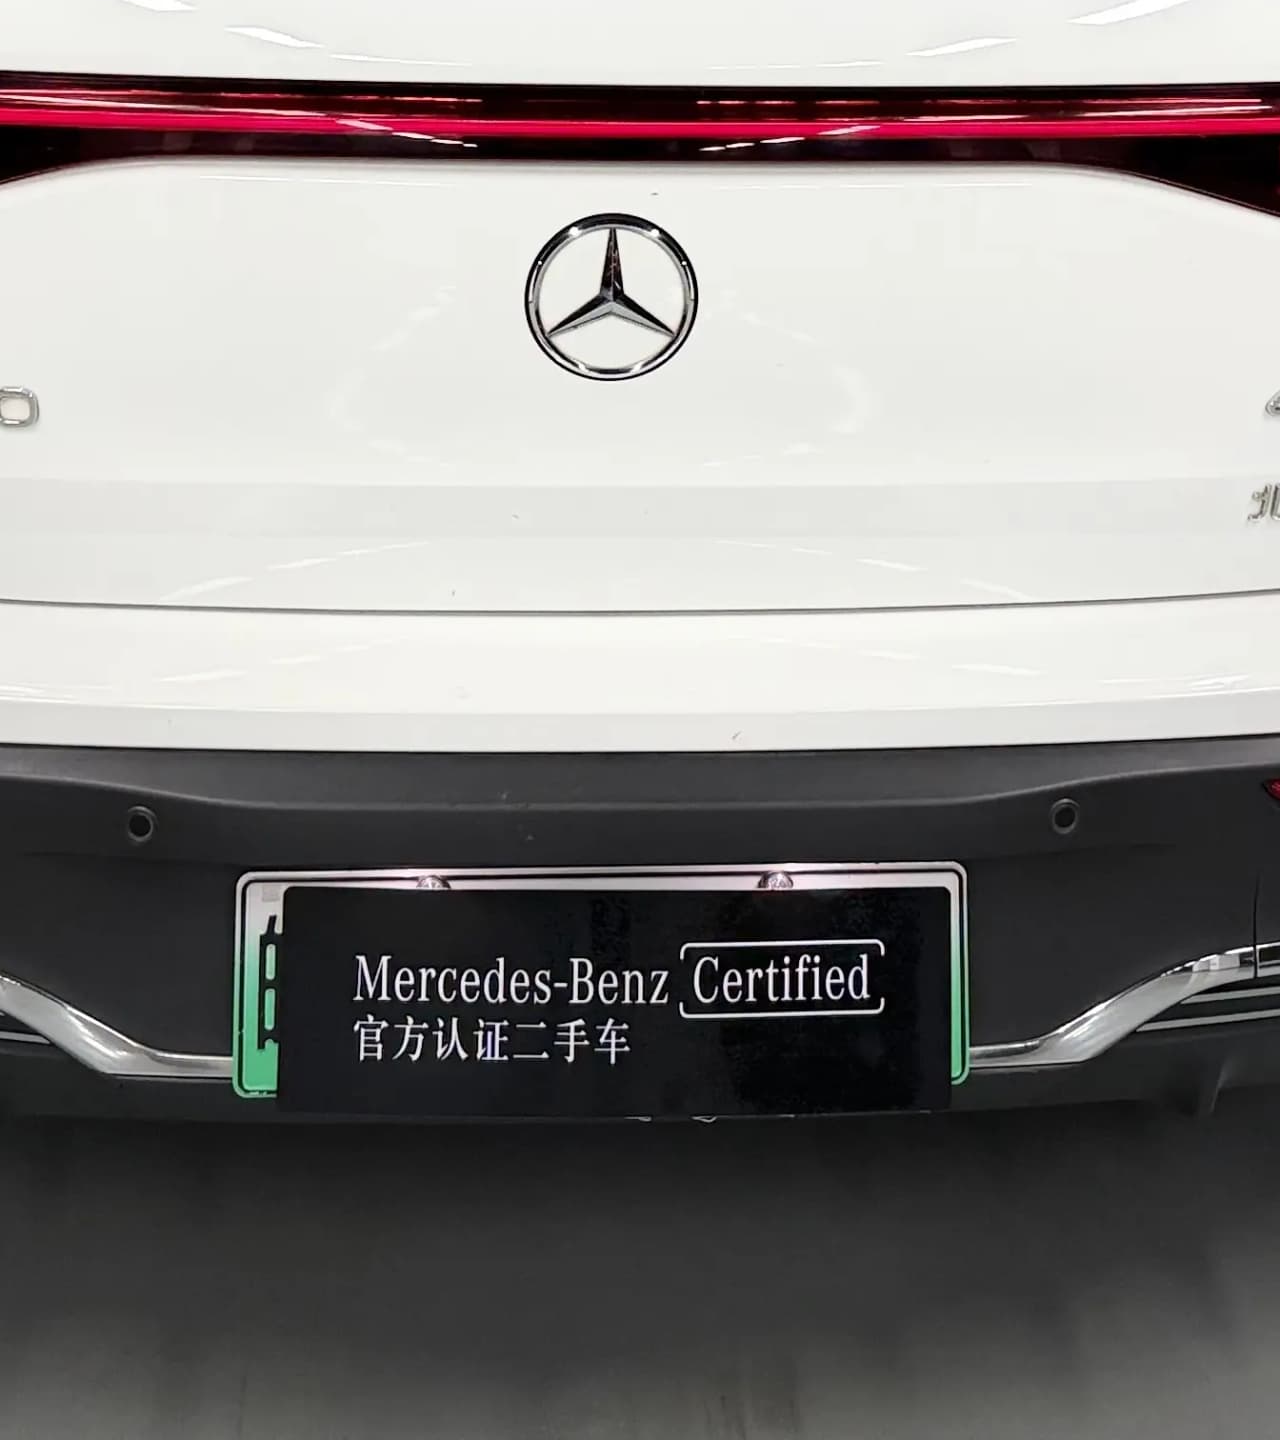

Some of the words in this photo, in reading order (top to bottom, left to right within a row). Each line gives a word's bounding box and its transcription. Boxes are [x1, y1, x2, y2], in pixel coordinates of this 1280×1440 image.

[353, 954, 670, 1006] Mercedes-Benz
[692, 953, 872, 1004] Certified
[352, 1014, 632, 1064] 官方认证二手车
